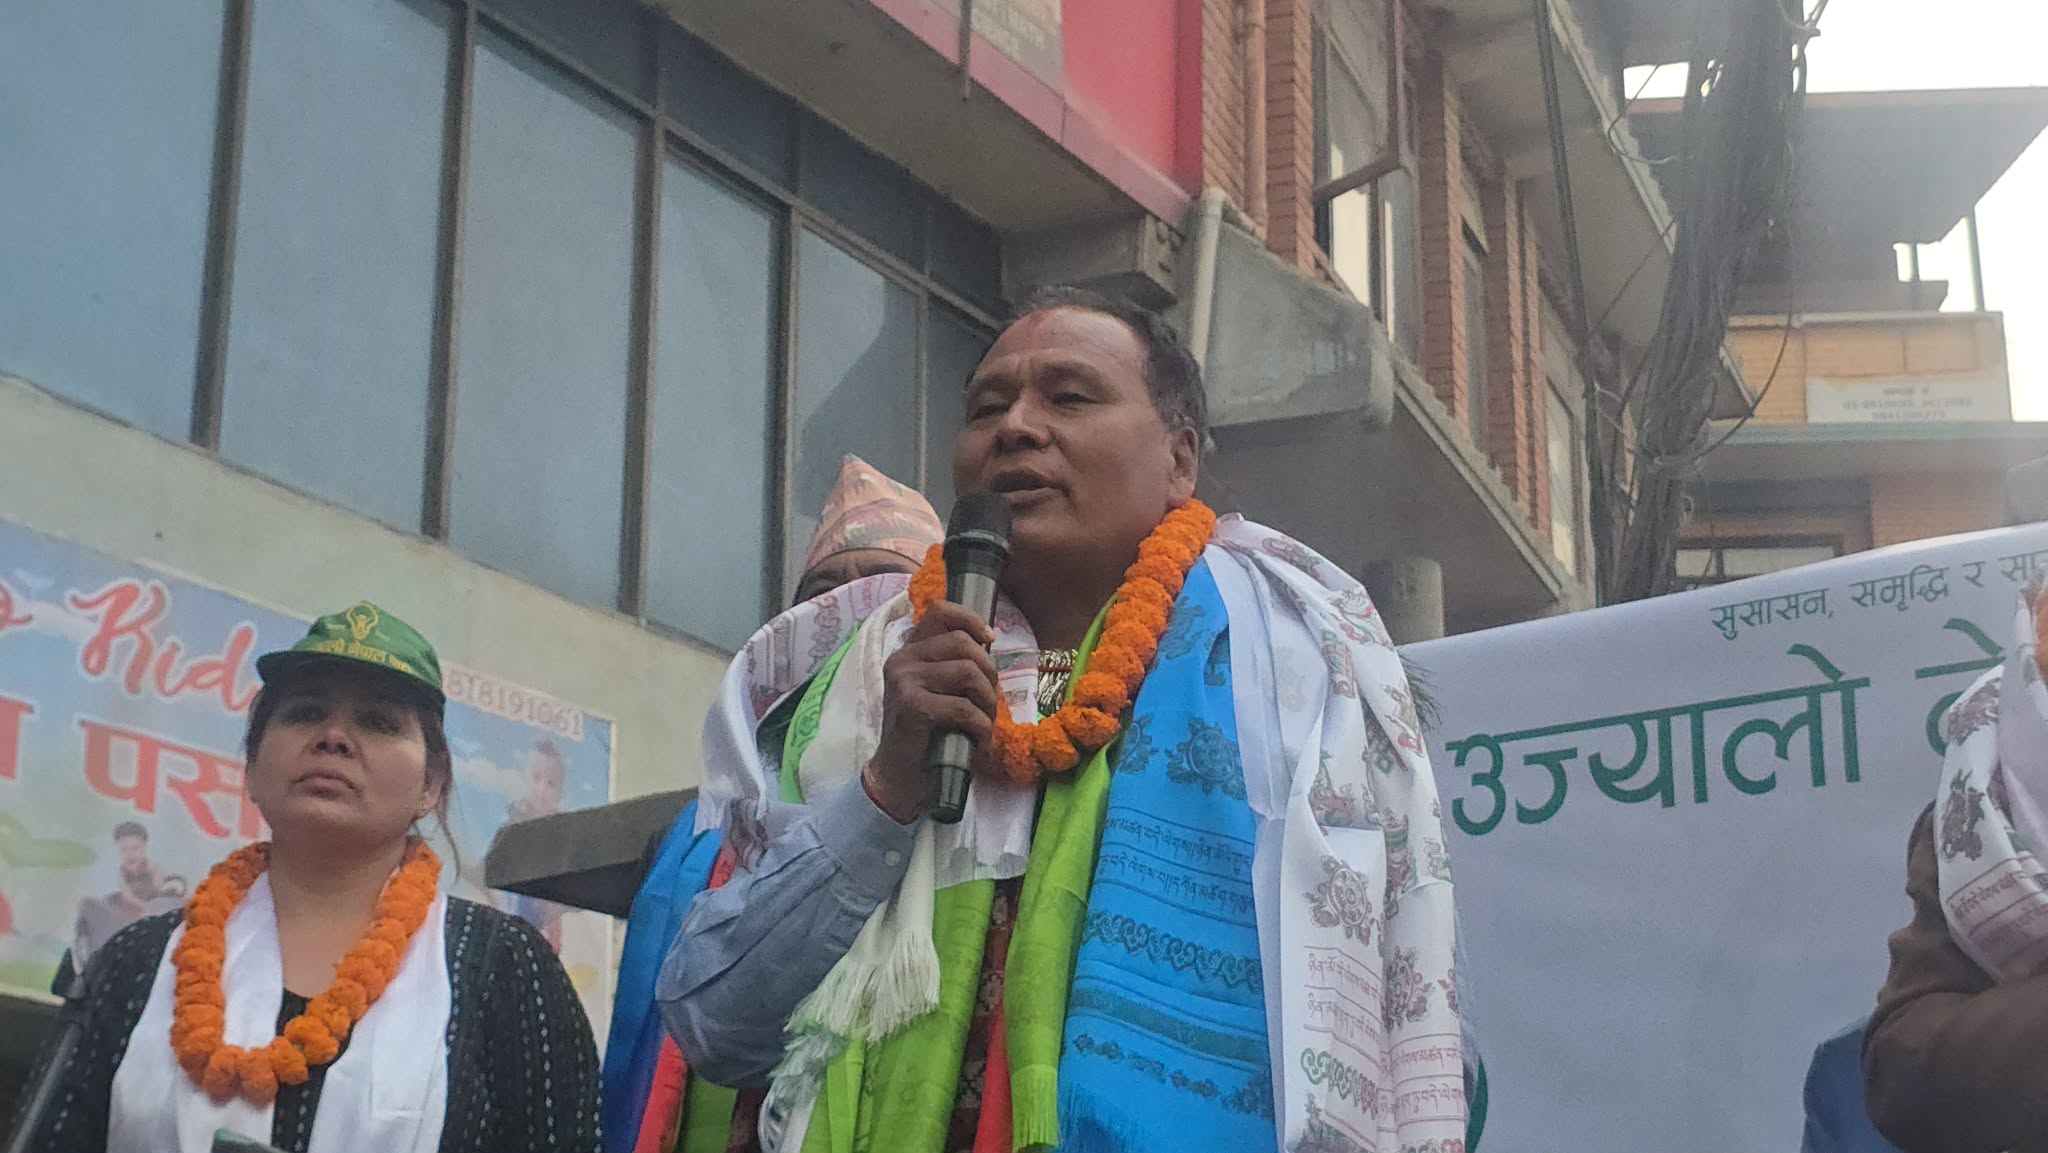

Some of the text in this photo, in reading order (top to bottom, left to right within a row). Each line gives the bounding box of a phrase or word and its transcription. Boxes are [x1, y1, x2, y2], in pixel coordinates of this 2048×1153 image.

[68, 583, 262, 712] Kid
[1711, 549, 2048, 641] सुसासन, समृद्धि र सा
[446, 667, 583, 736] 818191061
[1445, 643, 1871, 836] उज्यालो
[78, 718, 262, 840] पस
